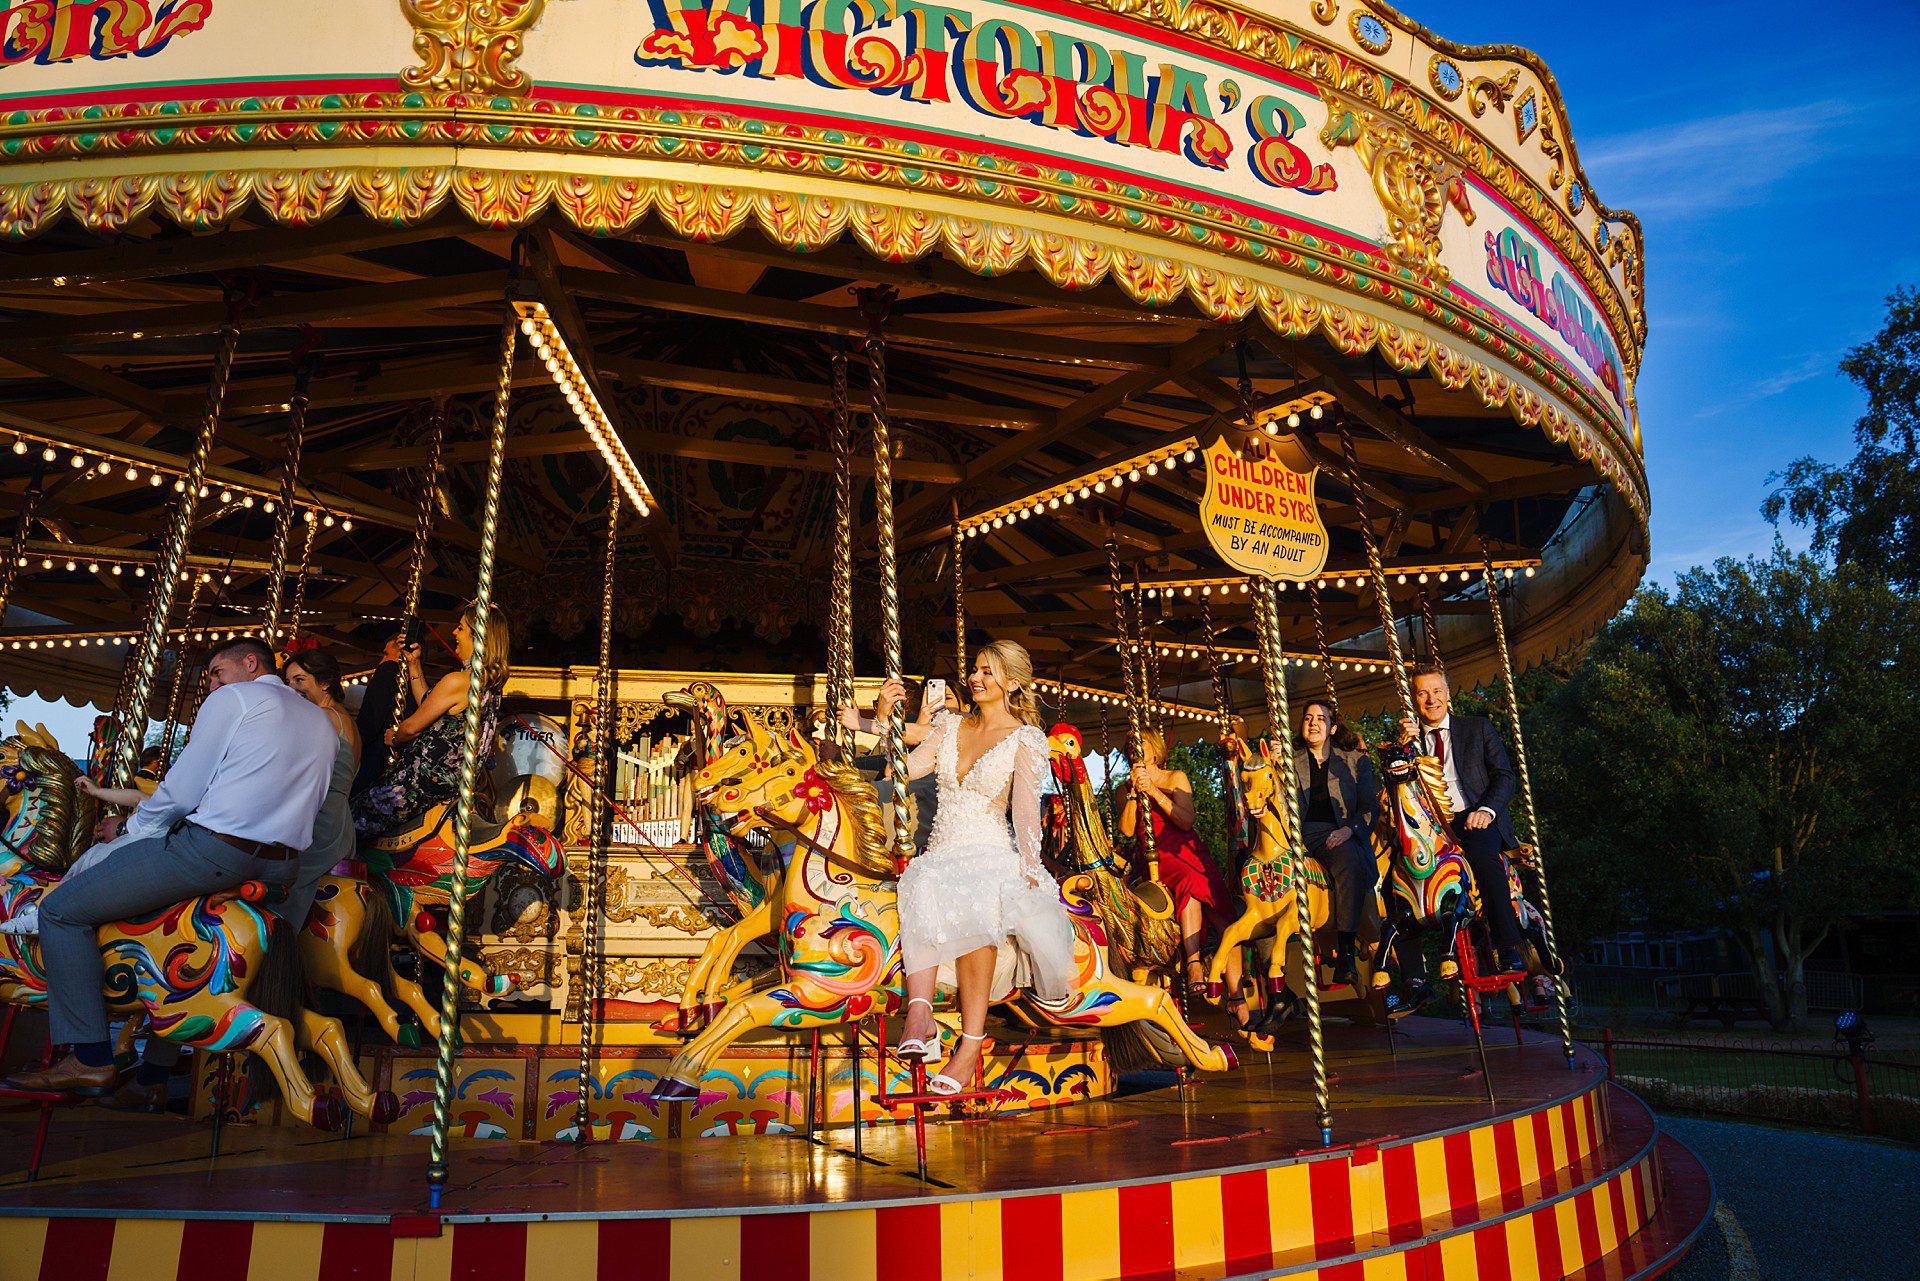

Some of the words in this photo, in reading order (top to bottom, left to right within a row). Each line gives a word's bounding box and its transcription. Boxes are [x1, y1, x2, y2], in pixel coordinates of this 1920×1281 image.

[1242, 436, 1277, 463] ALL
[1214, 453, 1307, 496] CHILDREN
[1218, 483, 1276, 516] UNDER
[1279, 497, 1315, 524] 5YRS
[1212, 513, 1241, 531] MUST
[1243, 518, 1258, 535] BE
[1259, 523, 1322, 547] ACCOMPANIED
[1230, 535, 1249, 551] BY
[1252, 541, 1270, 555] AN
[1272, 544, 1306, 563] ADULT
[518, 729, 555, 746] TIGER
